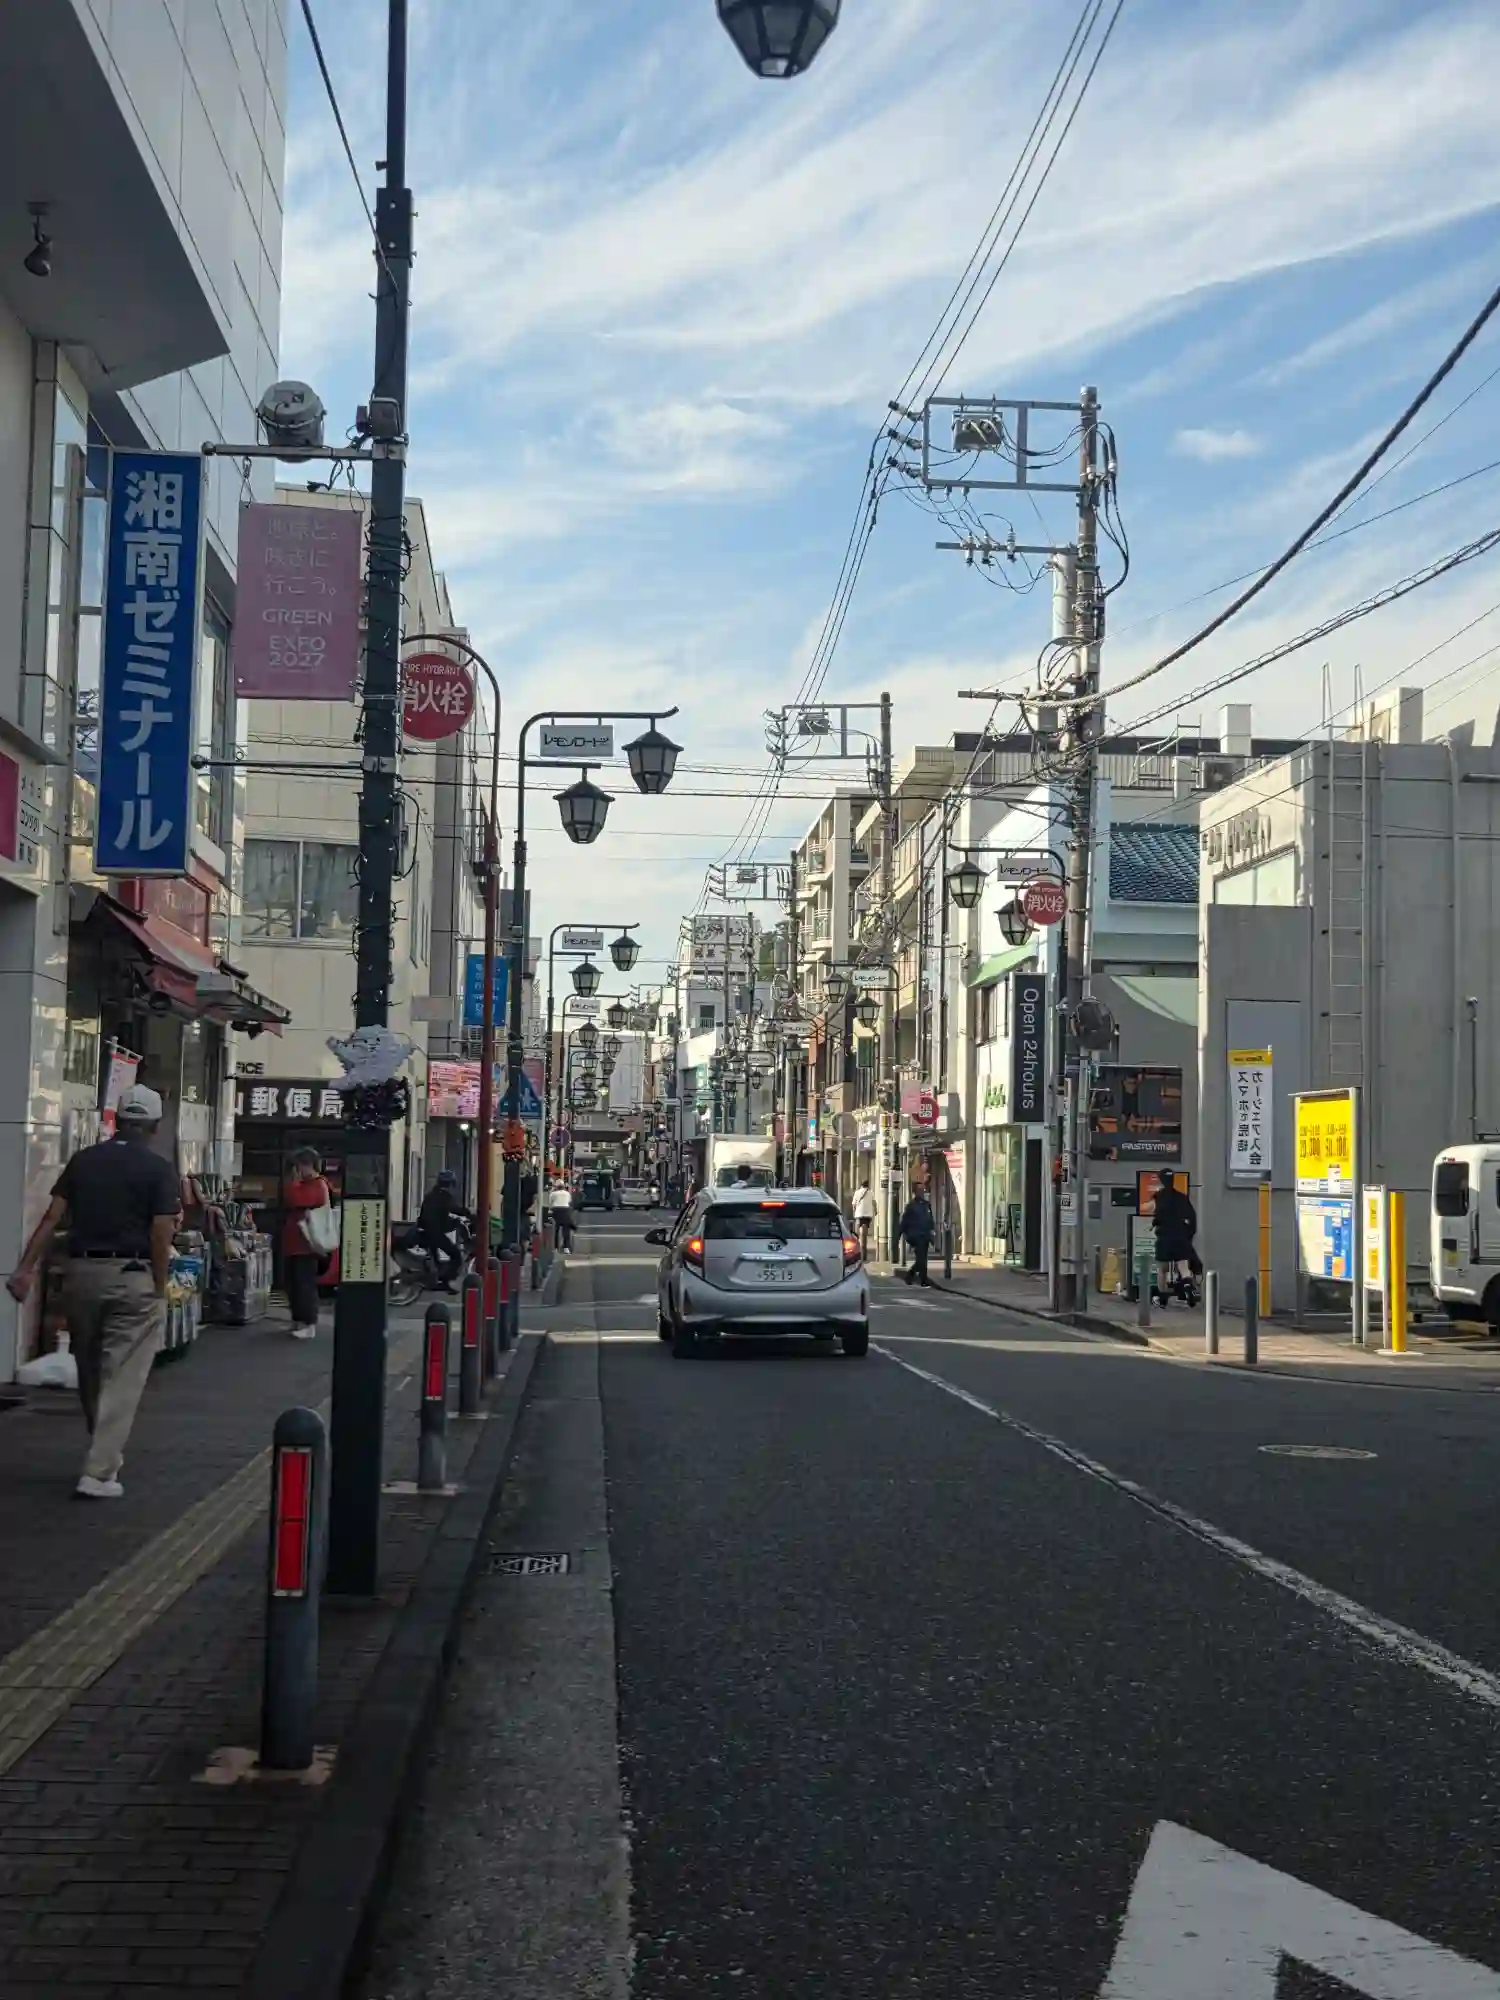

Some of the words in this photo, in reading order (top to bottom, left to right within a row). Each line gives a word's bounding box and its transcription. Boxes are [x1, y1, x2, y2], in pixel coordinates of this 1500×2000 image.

[263, 574, 337, 596] 行こう。
[262, 608, 332, 627] GREEN
[268, 635, 326, 652] EXPO
[113, 470, 184, 852] 湘南ゼミナール
[268, 652, 326, 667] 2027
[423, 664, 460, 676] HYDRANT
[544, 733, 609, 748] レモンロード
[1027, 893, 1065, 912] 消火栓
[1020, 988, 1039, 1035] Open
[1022, 1040, 1038, 1109] 24hours
